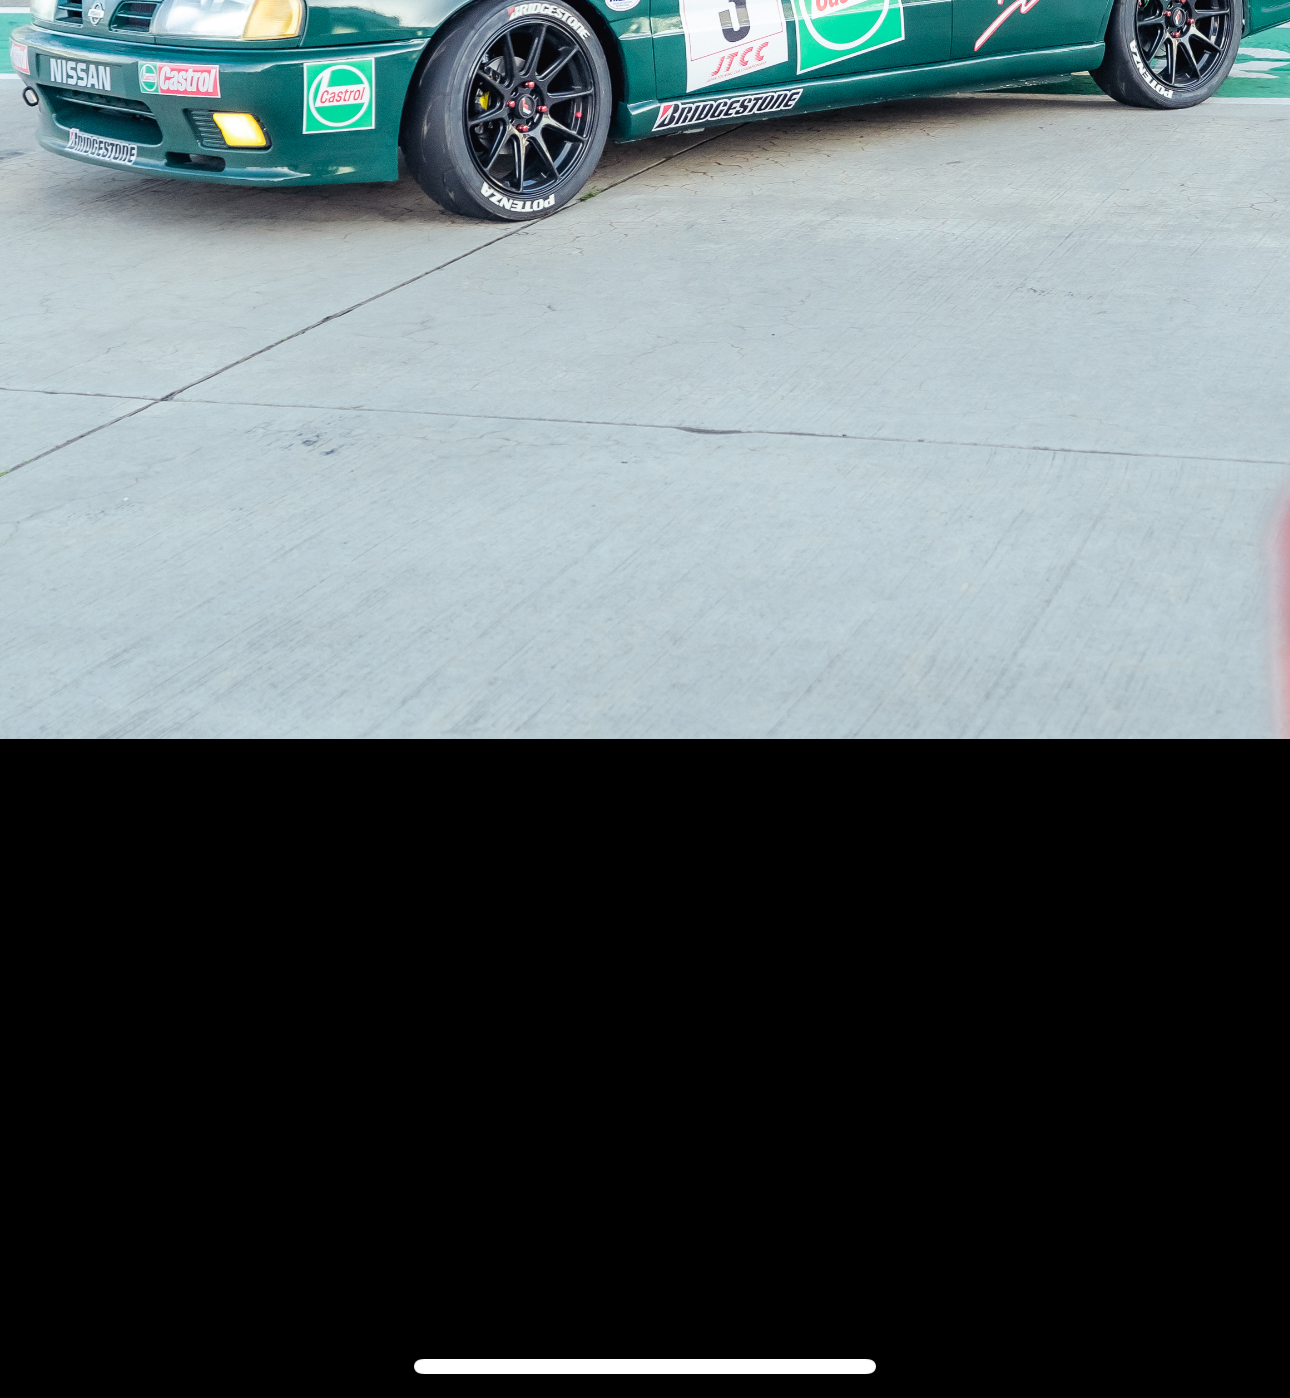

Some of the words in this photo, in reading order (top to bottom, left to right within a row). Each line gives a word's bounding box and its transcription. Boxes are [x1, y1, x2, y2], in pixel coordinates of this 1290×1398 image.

[507, 2, 591, 41] BRIDGESTONE
[49, 58, 112, 91] NISSAN
[709, 41, 769, 77] JTCC
[1129, 39, 1174, 99] POTENZA
[160, 65, 216, 93] Castrol
[320, 87, 366, 104] Castrol
[653, 90, 802, 129] BRIDGESTONE
[66, 130, 136, 163] BRIDGESTONE
[480, 181, 556, 213] POTENZA
